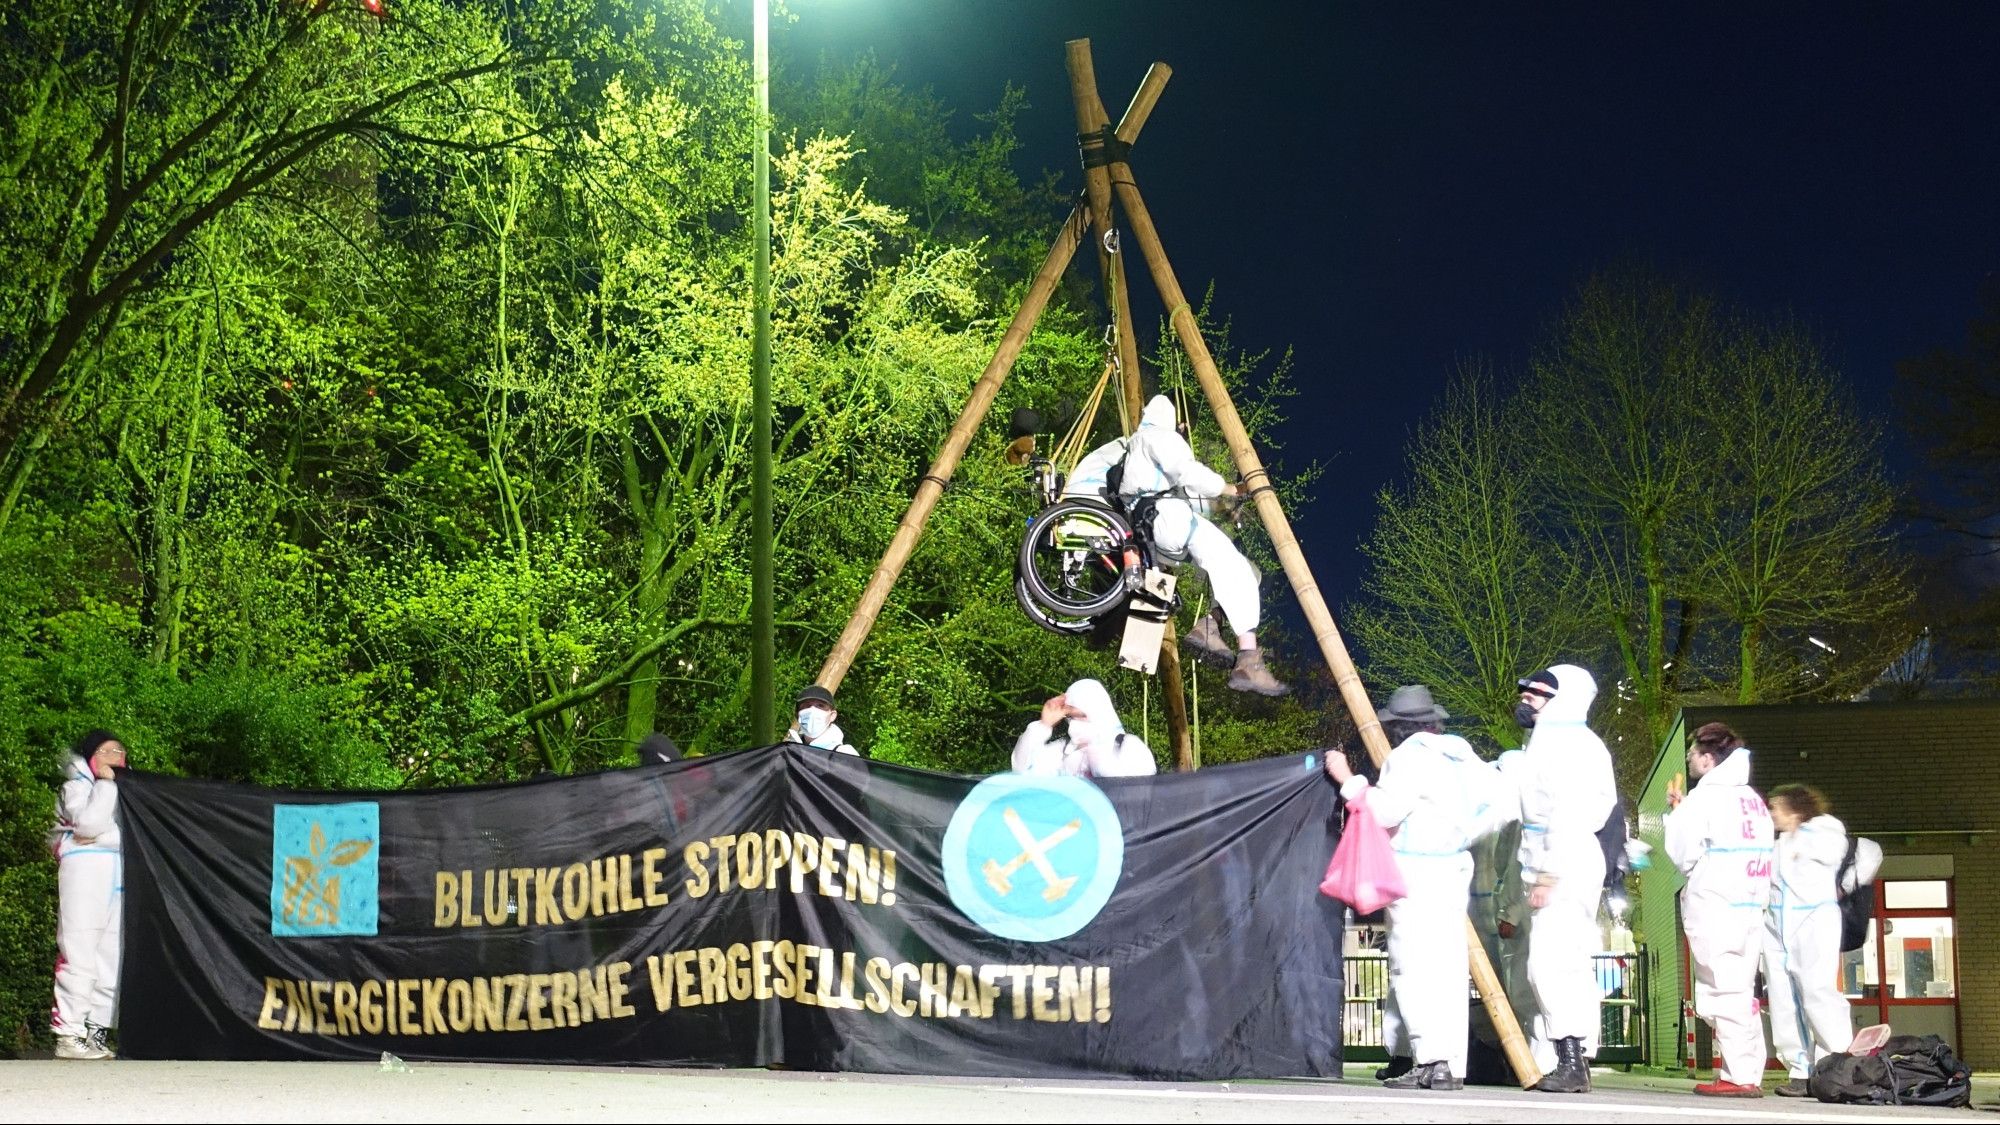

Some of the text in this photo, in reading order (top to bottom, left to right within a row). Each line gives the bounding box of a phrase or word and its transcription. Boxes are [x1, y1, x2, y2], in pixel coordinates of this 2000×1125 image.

[434, 828, 897, 928] BLUTKOHLE STOPPEN!
[258, 939, 1112, 1036] ENERGIEKONZERNE VERGESELLSCHAFTEN!
